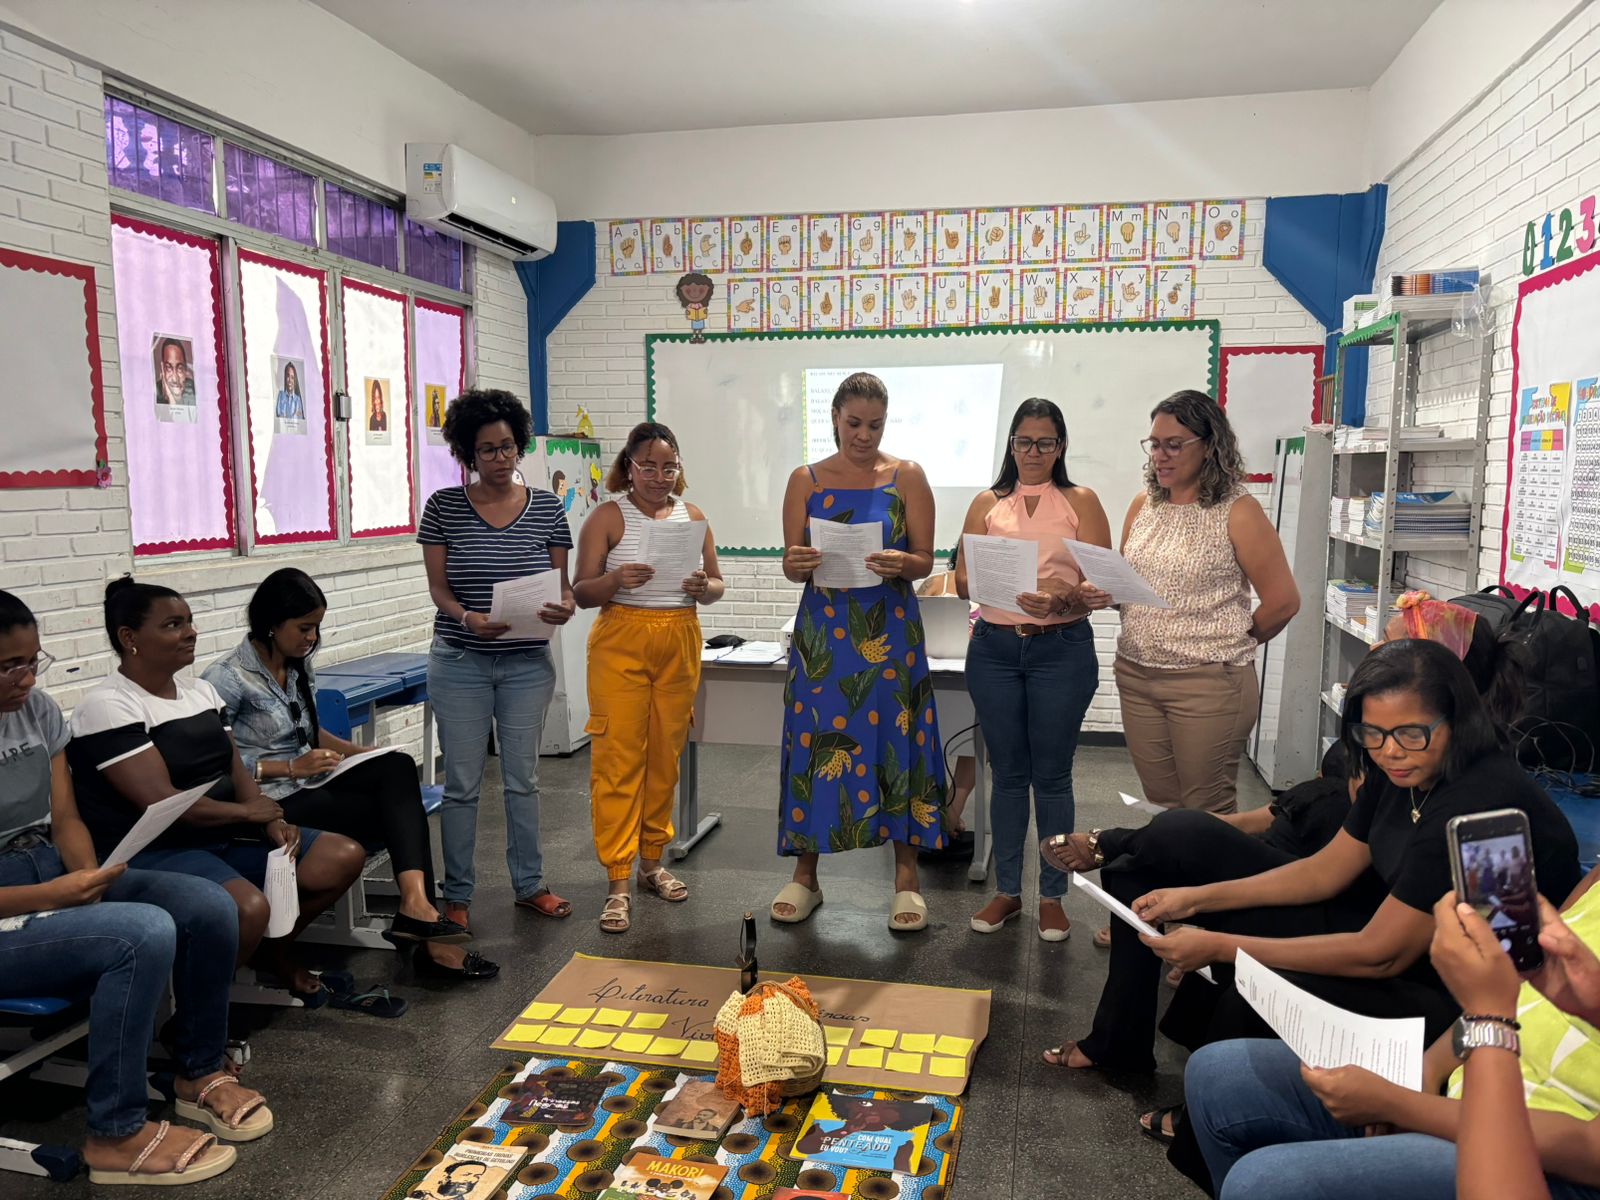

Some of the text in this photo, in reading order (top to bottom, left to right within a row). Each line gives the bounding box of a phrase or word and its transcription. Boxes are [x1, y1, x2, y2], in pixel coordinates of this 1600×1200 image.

[1069, 212, 1076, 223] L
[1112, 210, 1122, 221] M
[1158, 209, 1168, 220] N
[1208, 206, 1220, 218] O
[896, 218, 922, 229] H h
[980, 214, 1006, 226] J j
[1024, 213, 1051, 224] K k
[655, 224, 681, 236] B b
[694, 224, 702, 235] C
[734, 222, 759, 234] D d
[773, 222, 779, 232] E
[813, 220, 838, 232] F f
[853, 219, 880, 231] G g
[614, 227, 622, 238] A
[1523, 195, 1595, 276] 0 1 2 3
[981, 276, 989, 286] V
[1026, 274, 1038, 285] W
[1070, 273, 1078, 283] X
[1115, 270, 1145, 284] Y y
[1160, 271, 1168, 282] Z
[814, 282, 820, 293] R
[856, 280, 862, 291] S
[896, 279, 920, 290] T t
[939, 278, 946, 288] U
[733, 284, 759, 297] P p
[772, 282, 798, 296] Q q
[588, 978, 709, 1007] Literatura
[823, 1137, 890, 1151] PENTEADO
[646, 1161, 705, 1178] MAKORI
